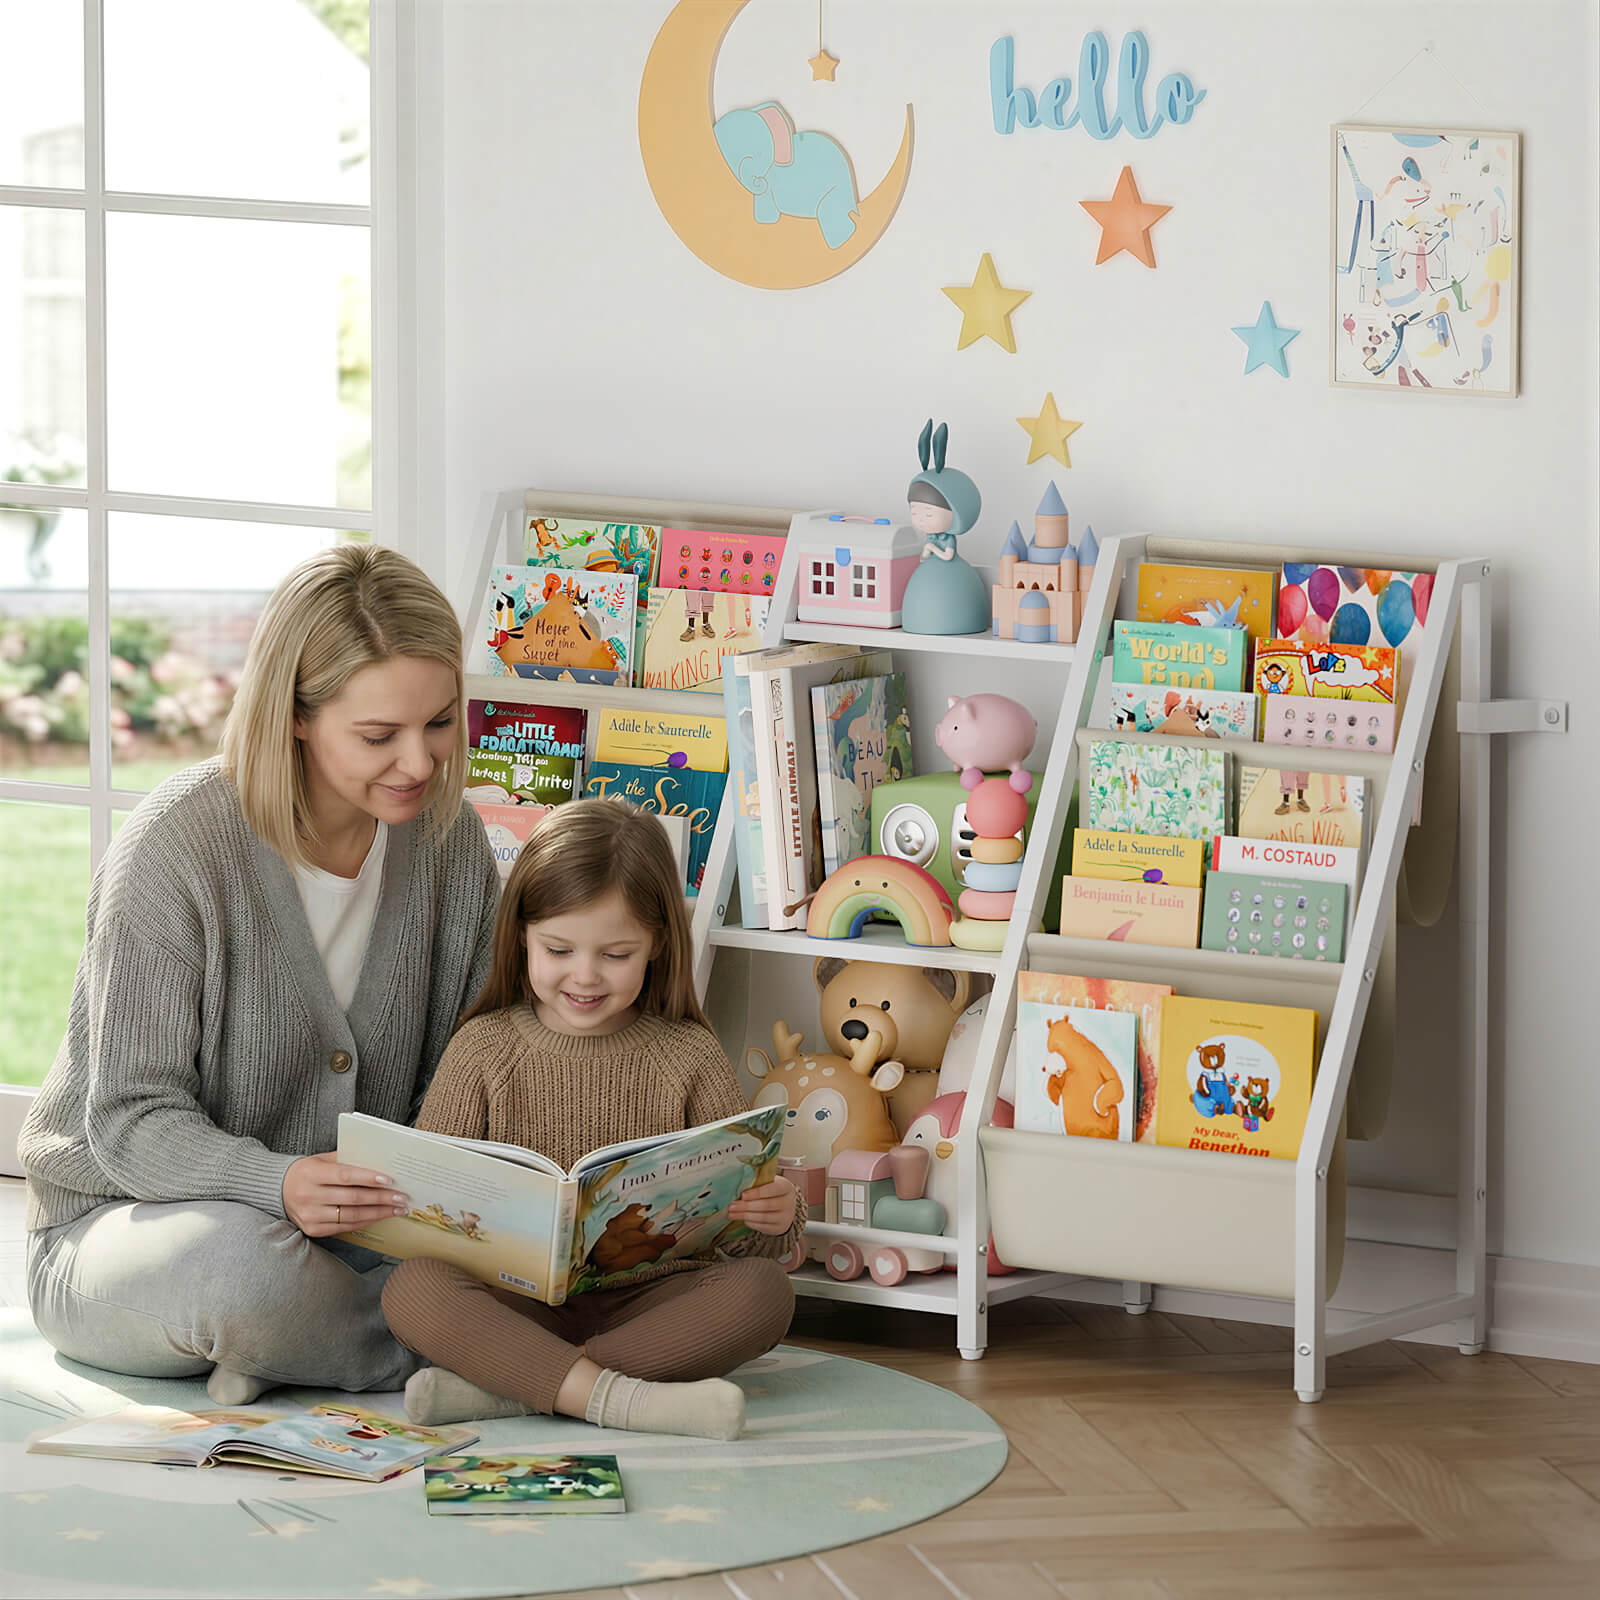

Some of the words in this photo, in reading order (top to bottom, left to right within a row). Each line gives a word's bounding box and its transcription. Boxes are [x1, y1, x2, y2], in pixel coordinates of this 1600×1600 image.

[990, 30, 1208, 140] hello
[1128, 636, 1227, 666] World's
[514, 721, 556, 740] LITTLE
[657, 721, 712, 739] Sauterelle
[848, 737, 892, 762] BEAU-
[786, 741, 799, 804] ANIMALS
[625, 778, 646, 797] the
[791, 807, 802, 857] LITTLE
[1083, 837, 1115, 852] Adèle
[1118, 839, 1128, 853] la
[1131, 841, 1185, 858] Sauterelle
[1241, 845, 1259, 860] M.
[1263, 847, 1337, 868] COSTAUD
[1072, 884, 1133, 905] Benjamin
[1136, 889, 1148, 905] le
[1151, 892, 1185, 909] Lutin
[1193, 1126, 1211, 1137] My
[1211, 1128, 1240, 1141] Dear,
[1188, 1137, 1271, 1157] Benethon
